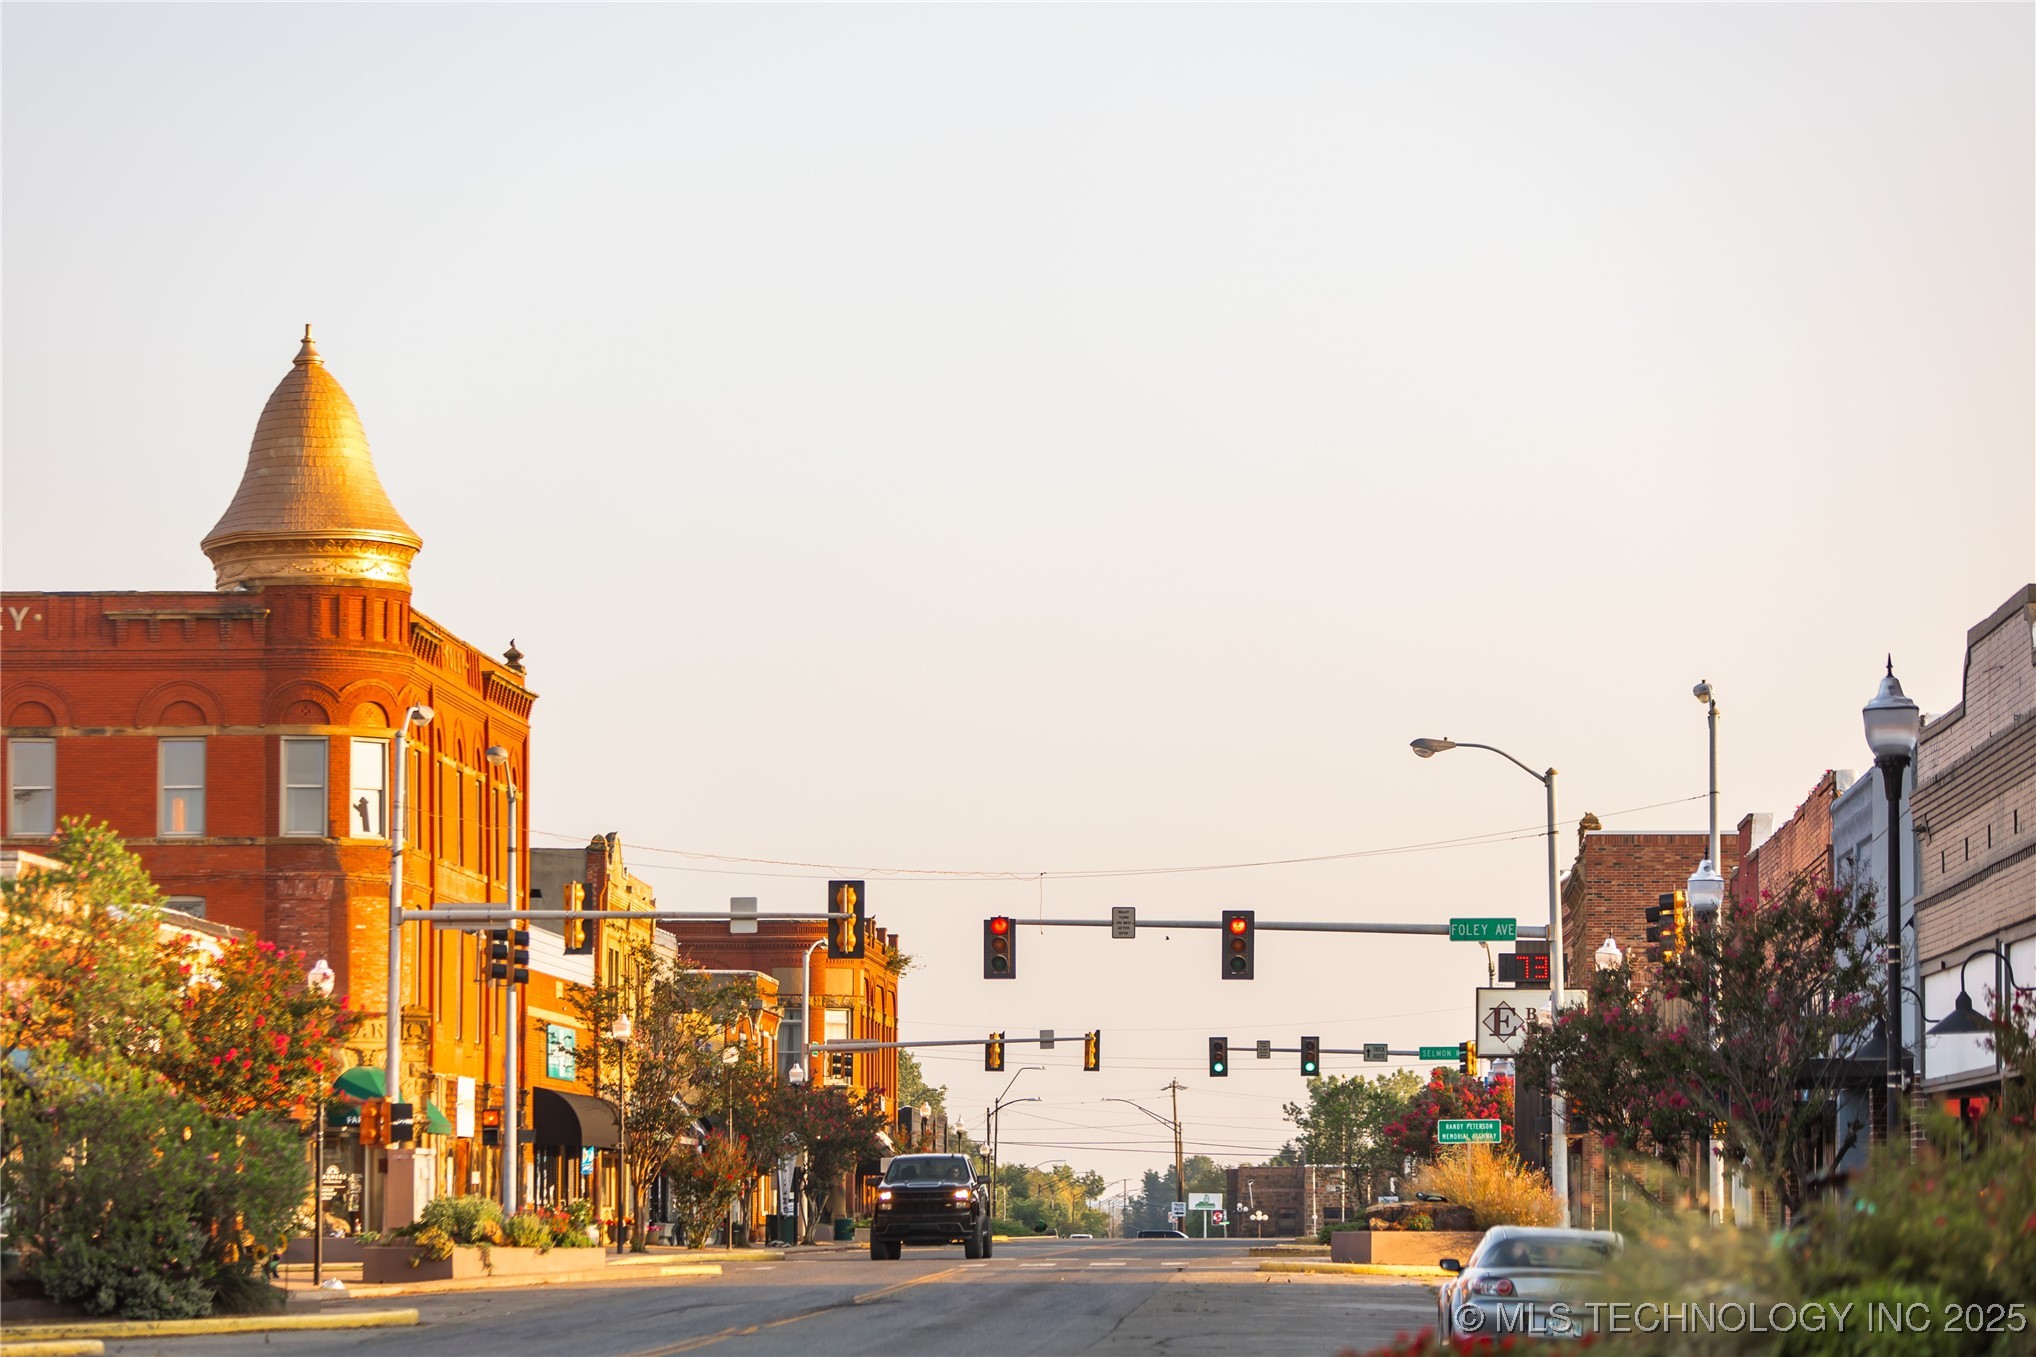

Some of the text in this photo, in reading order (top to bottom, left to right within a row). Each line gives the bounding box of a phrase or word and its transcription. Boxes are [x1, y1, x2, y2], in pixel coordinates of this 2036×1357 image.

[0, 606, 31, 632] Y
[1451, 924, 1514, 936] FOLEY AVE
[1516, 956, 1548, 979] 73
[1422, 1049, 1452, 1058] SELMON
[1466, 1122, 1494, 1130] PETERSON
